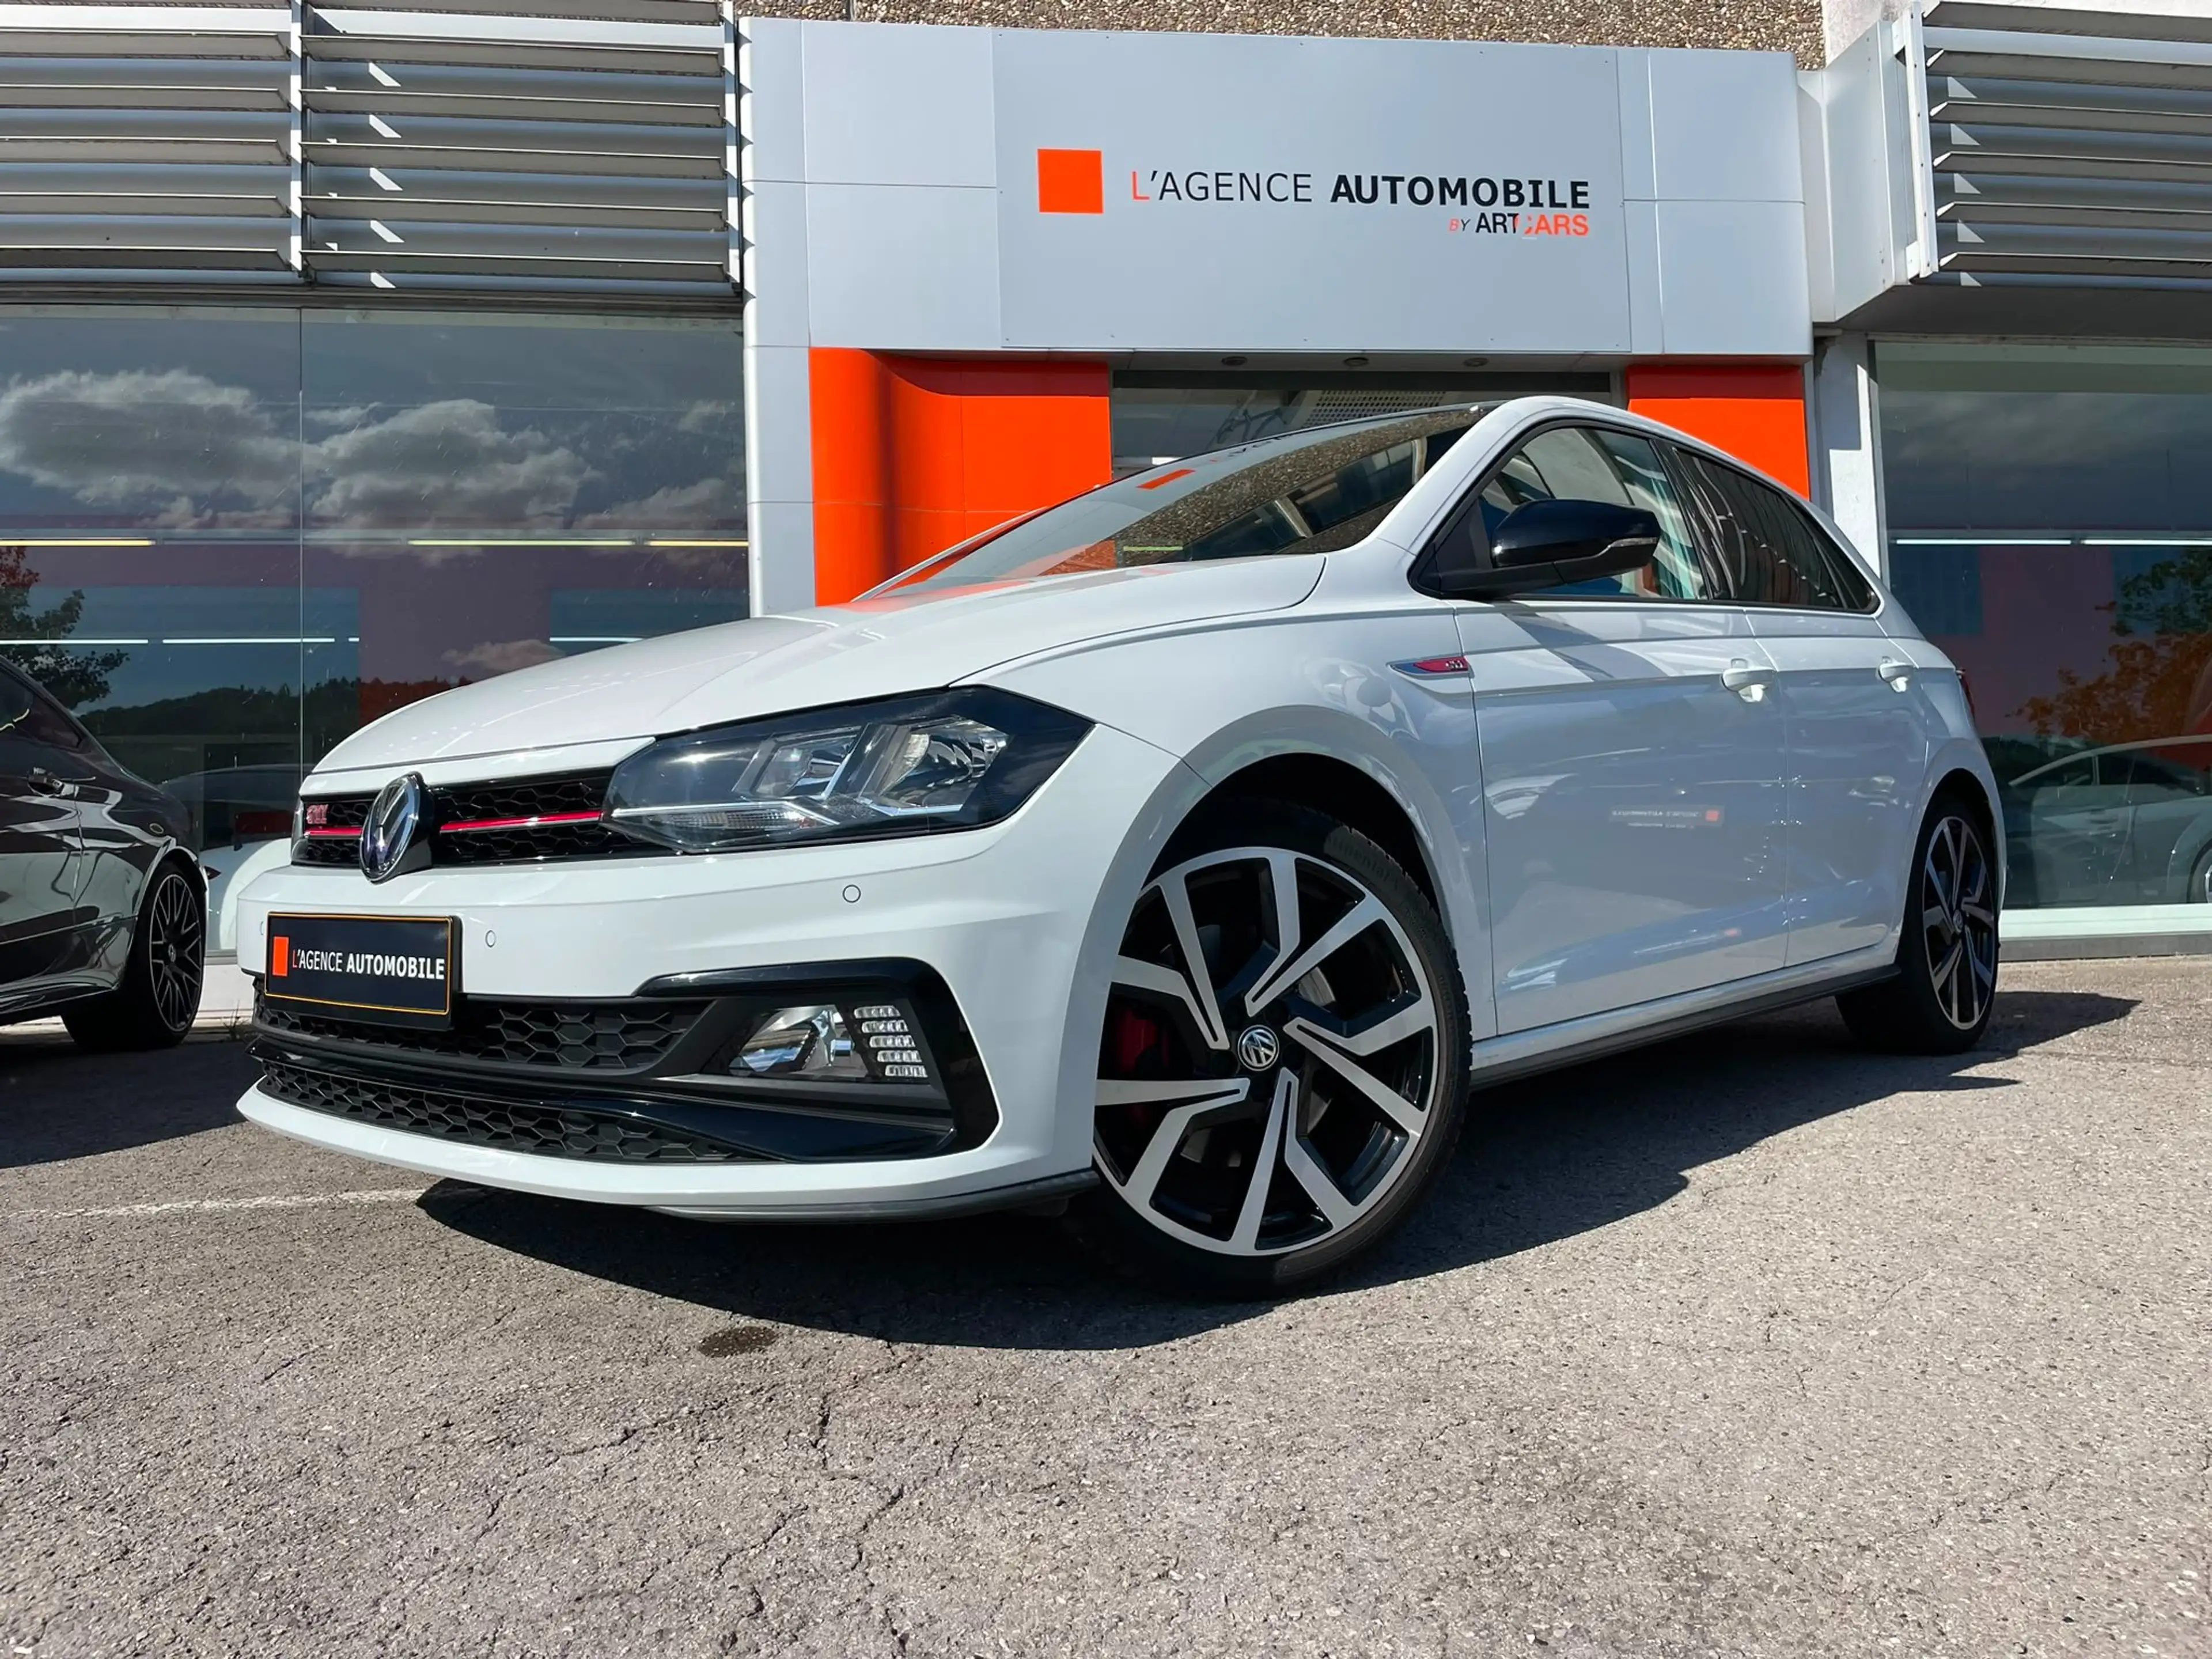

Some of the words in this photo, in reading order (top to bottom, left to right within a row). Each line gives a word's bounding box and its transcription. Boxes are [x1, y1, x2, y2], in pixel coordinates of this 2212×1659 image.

[1132, 171, 1312, 202] L'AGENCE
[1330, 175, 1590, 209] AUTOMOBILE
[1449, 218, 1471, 232] BY
[293, 949, 343, 972] L'AGENCE
[346, 953, 445, 979] AUTOMOBILE
